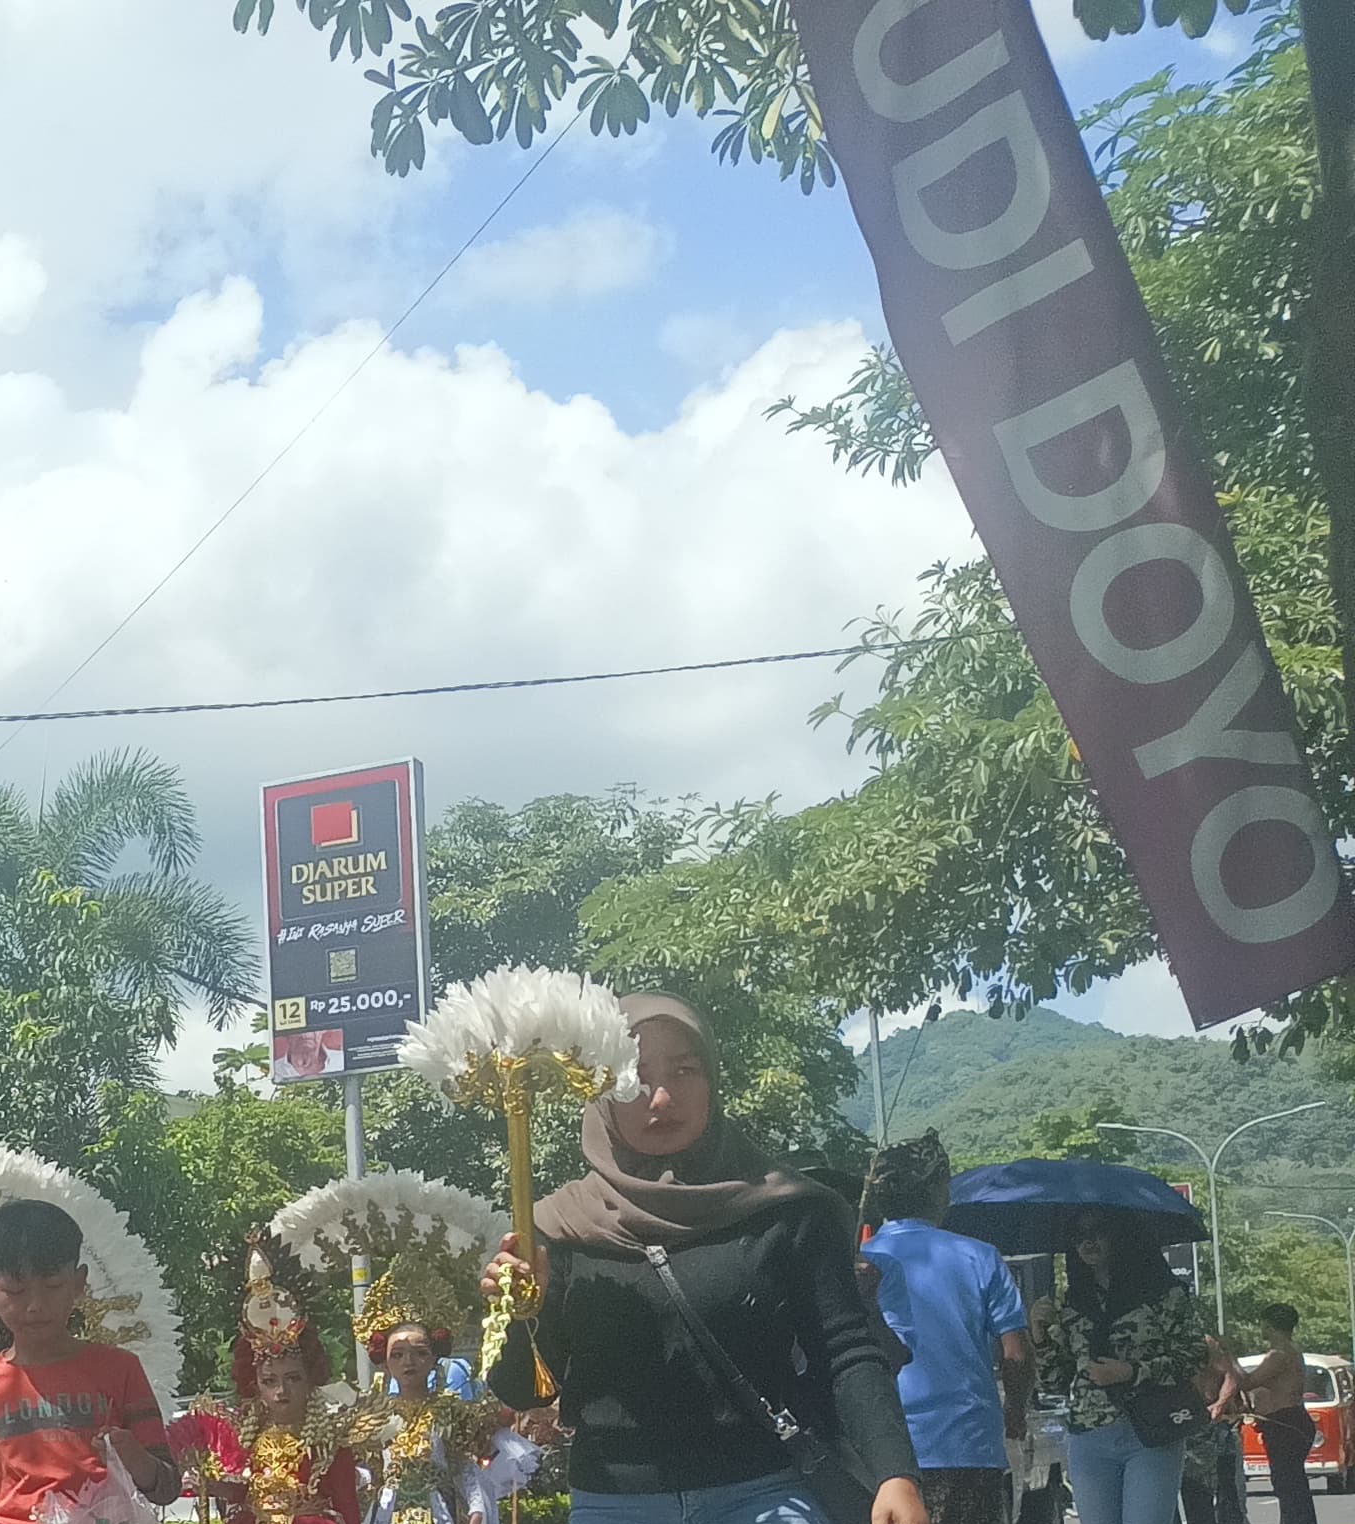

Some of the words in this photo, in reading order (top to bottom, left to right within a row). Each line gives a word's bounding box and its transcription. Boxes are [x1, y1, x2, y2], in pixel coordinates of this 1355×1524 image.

[993, 358, 1340, 944] DOYO
[291, 851, 388, 885] DJARUM
[302, 876, 378, 905] SUPER
[361, 909, 407, 933] SUPER
[279, 1002, 300, 1019] 12
[310, 1000, 325, 1012] Rp
[328, 990, 412, 1014] 25.000,-
[3, 1391, 109, 1425] LONDON
